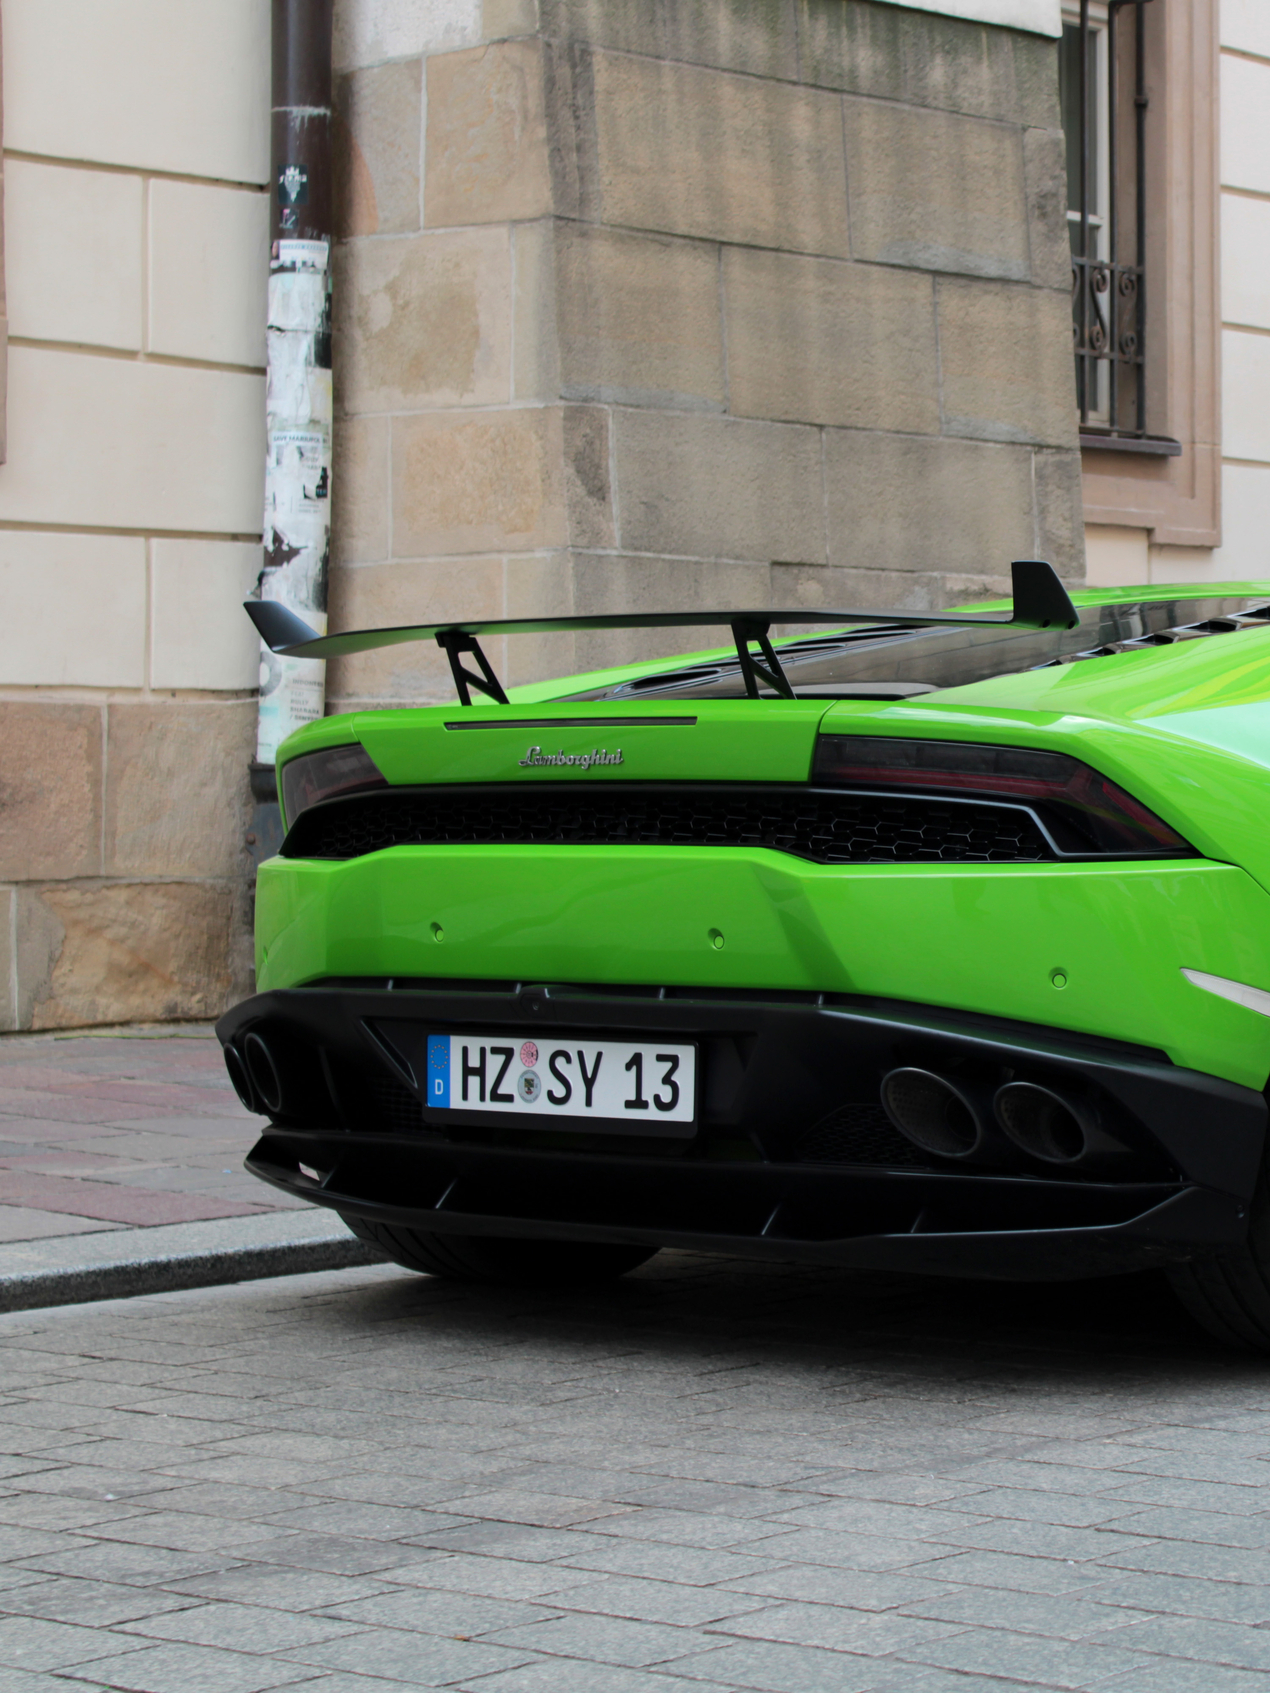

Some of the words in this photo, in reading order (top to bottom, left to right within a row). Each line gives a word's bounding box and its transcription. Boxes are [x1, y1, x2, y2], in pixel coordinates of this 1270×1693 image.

[518, 746, 624, 770] Lamborghini
[434, 1079, 444, 1095] D
[461, 1045, 515, 1103] HZ
[546, 1049, 604, 1107] SY
[624, 1052, 681, 1112] 13
